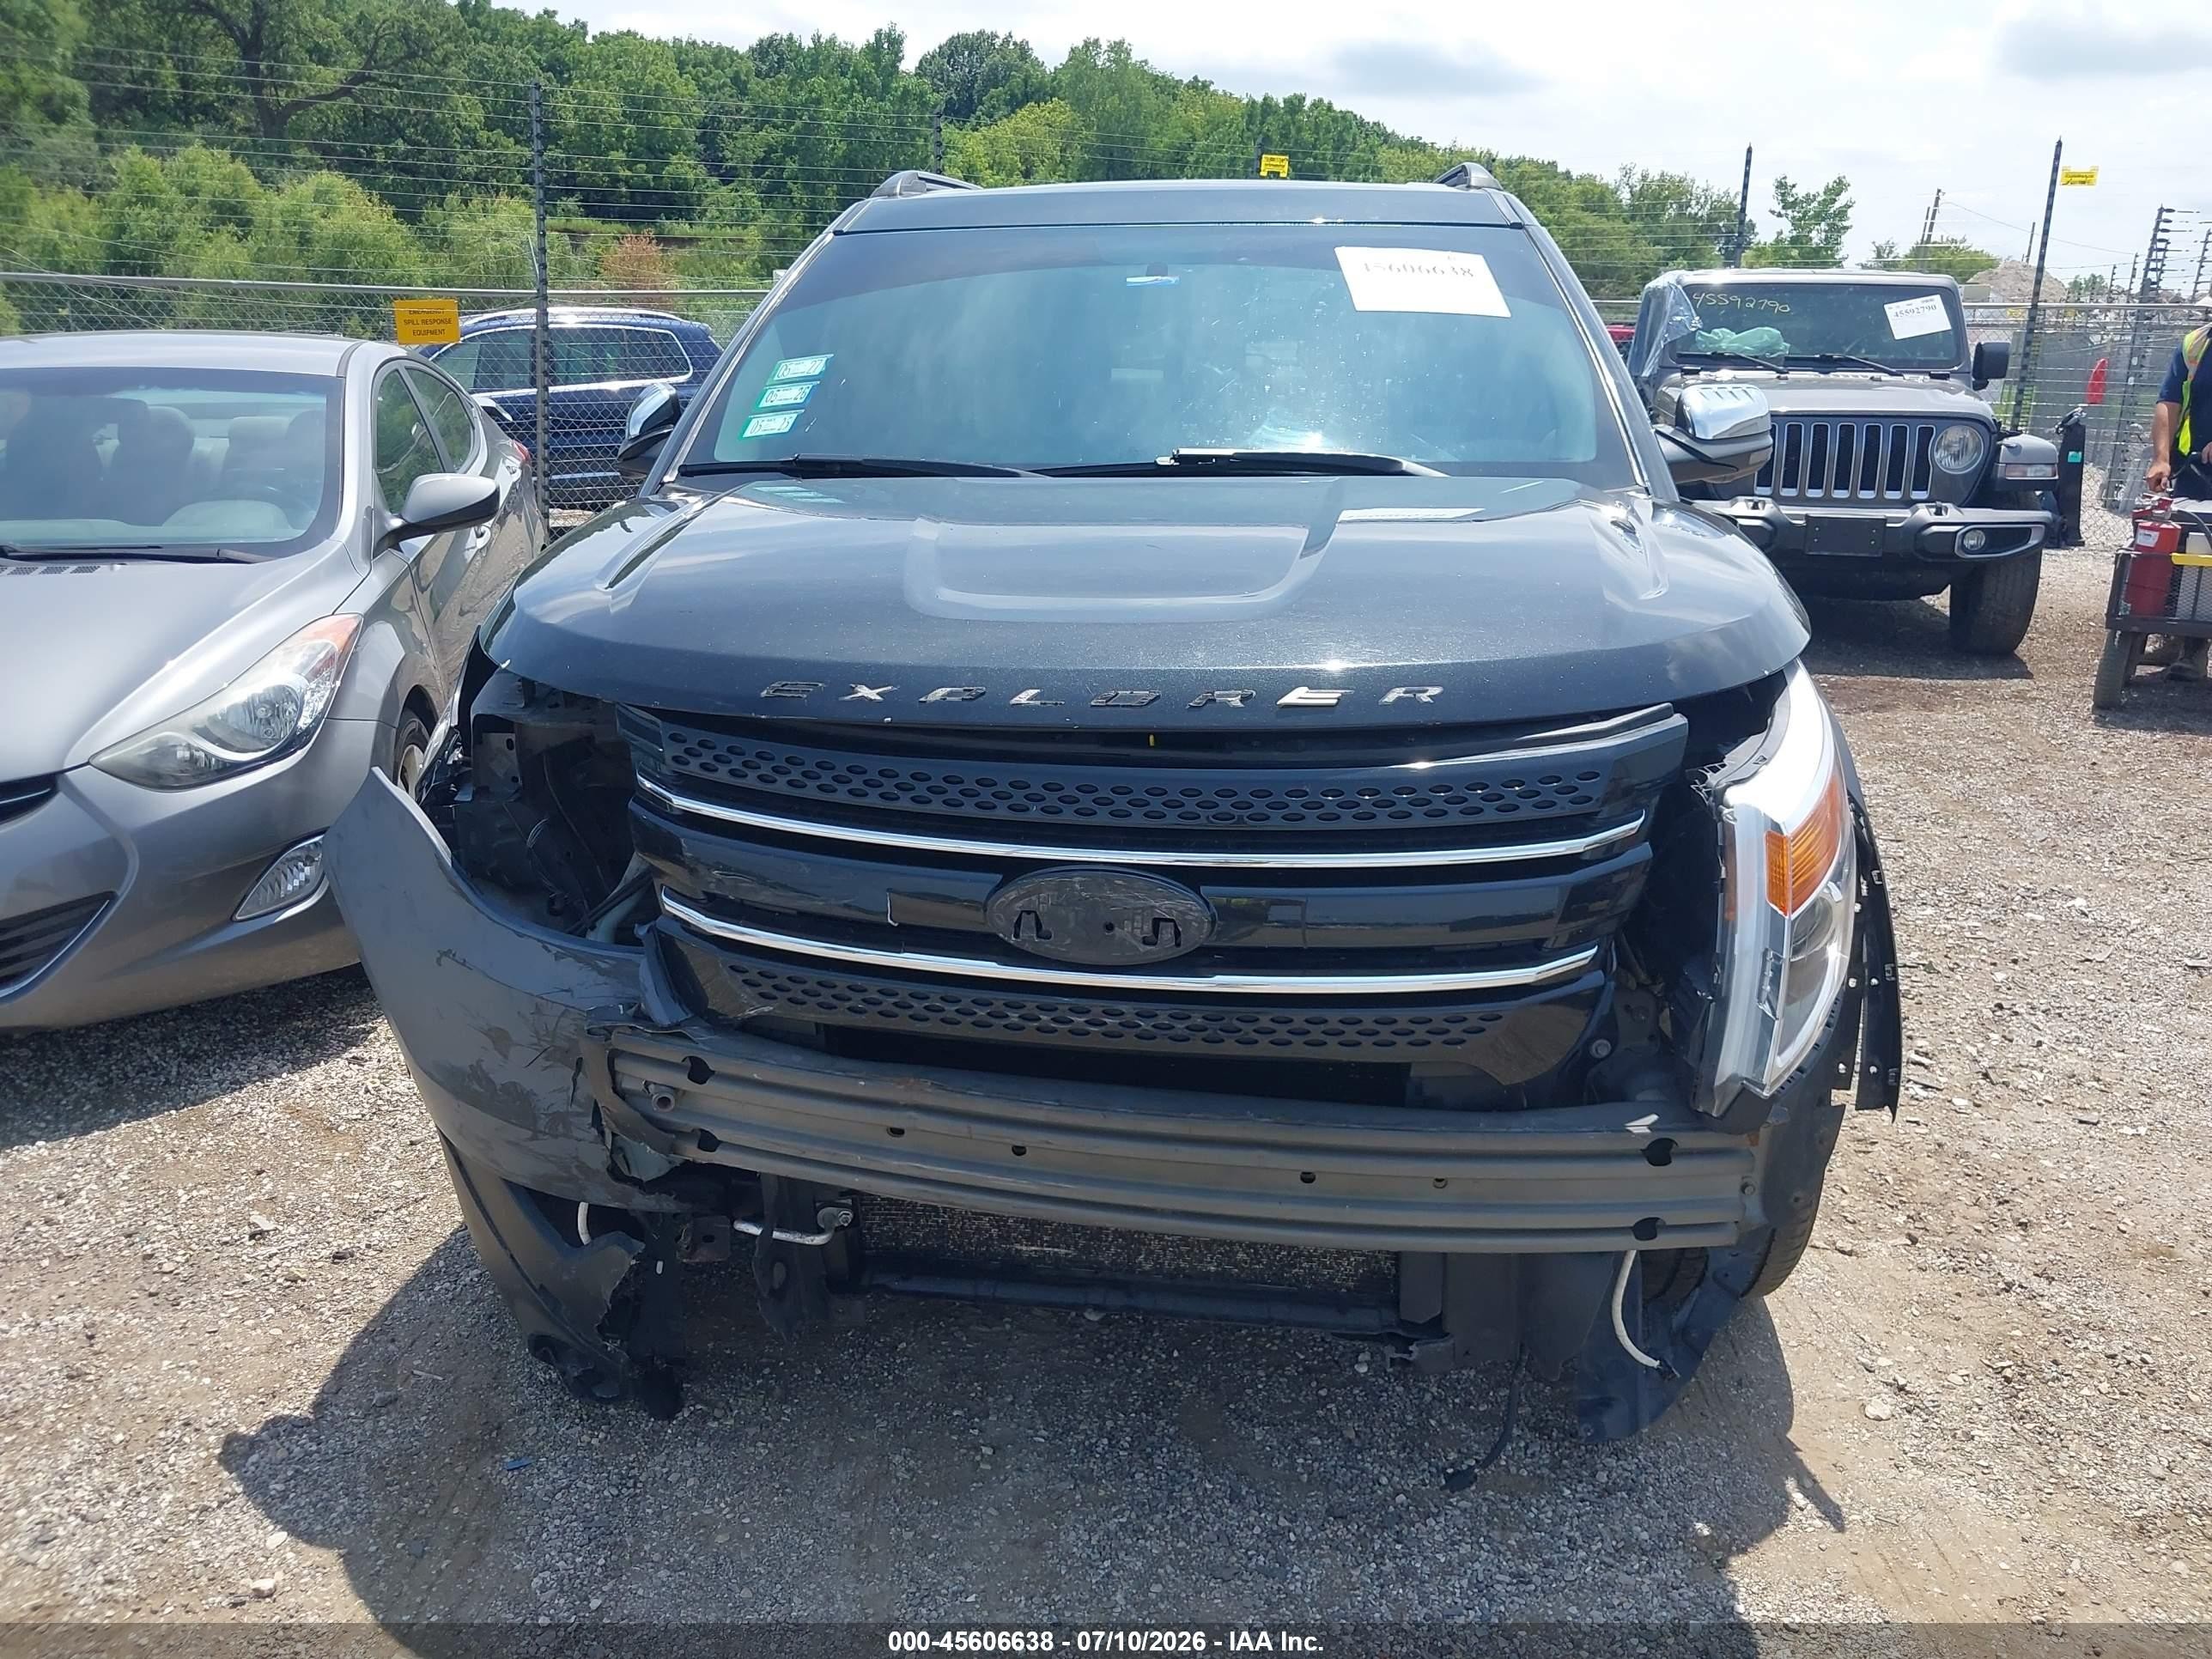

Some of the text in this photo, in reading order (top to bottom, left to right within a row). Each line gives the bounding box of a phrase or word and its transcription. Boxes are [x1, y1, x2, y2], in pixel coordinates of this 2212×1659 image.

[1692, 292, 1791, 313] 45592790
[1894, 304, 1937, 318] 45592790
[412, 328, 446, 337] EQUIPMENT
[761, 682, 1443, 708] EXPLORER
